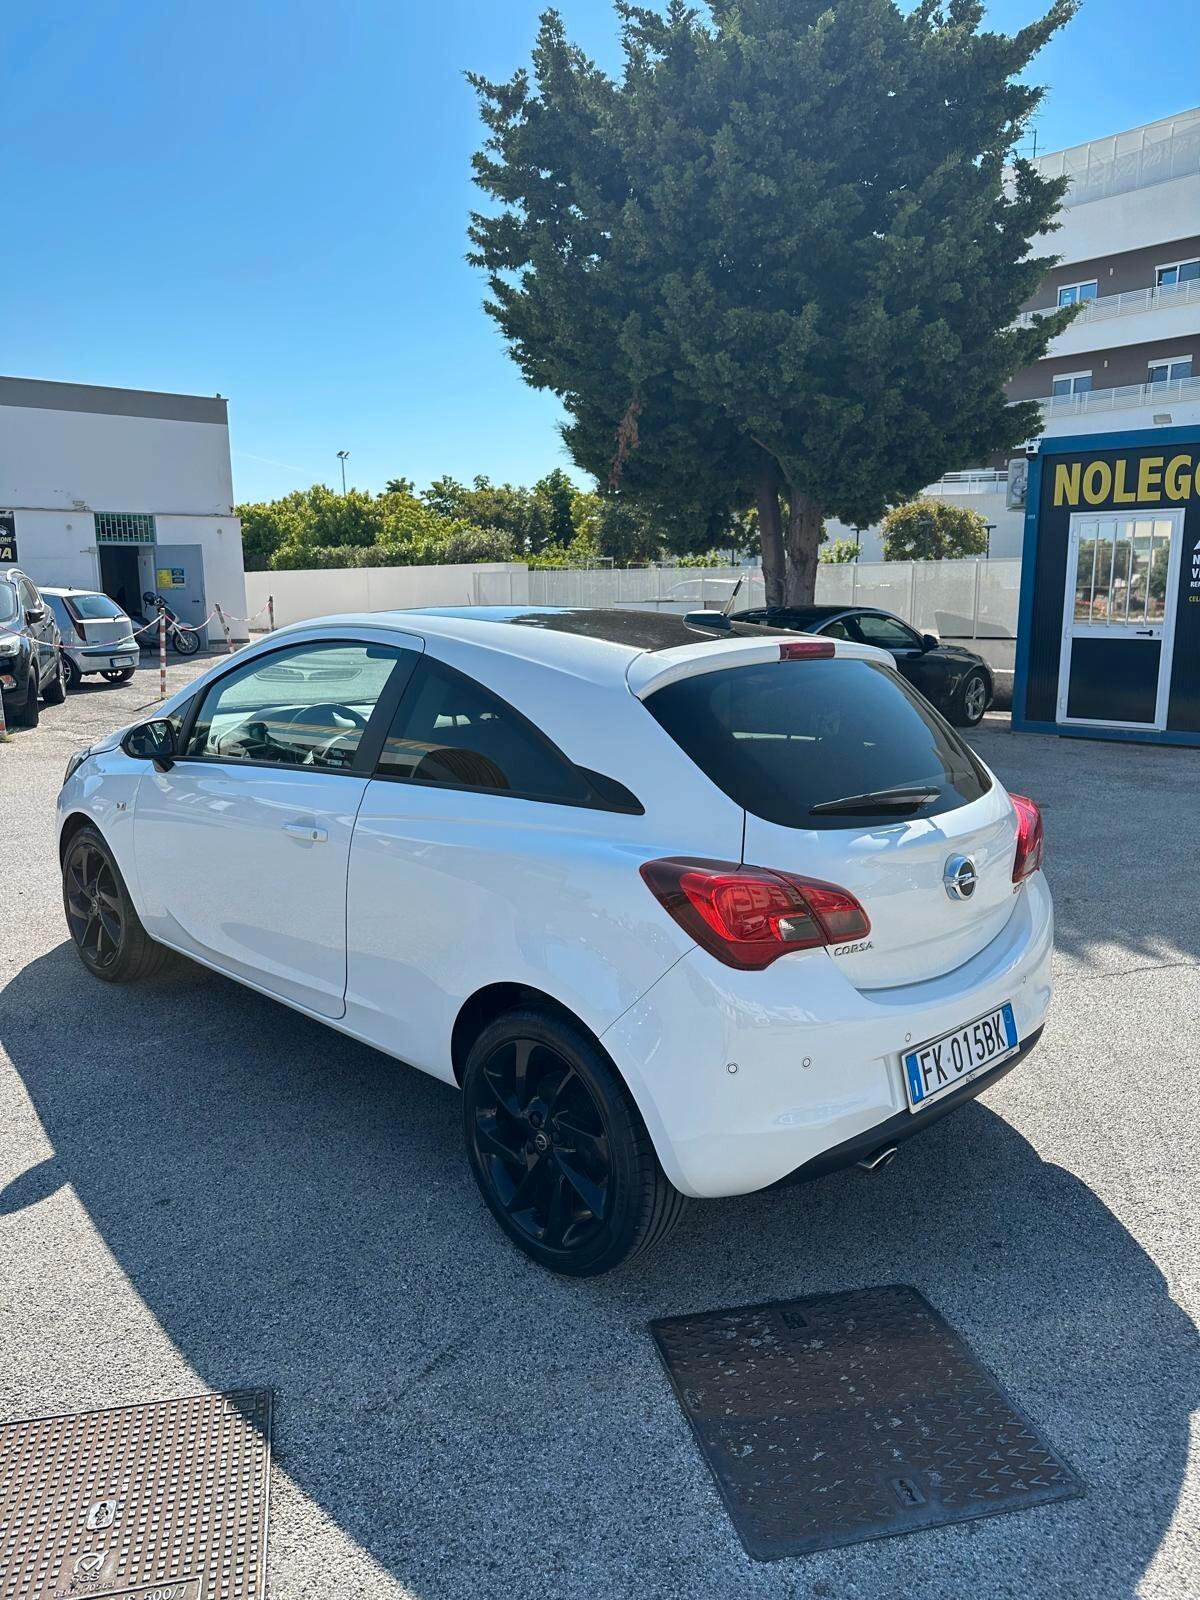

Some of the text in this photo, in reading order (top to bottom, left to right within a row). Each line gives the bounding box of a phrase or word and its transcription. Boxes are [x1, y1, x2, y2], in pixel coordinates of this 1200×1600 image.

[1053, 454, 1200, 506] NOLEG
[0, 547, 12, 560] A
[833, 940, 872, 957] CORSA
